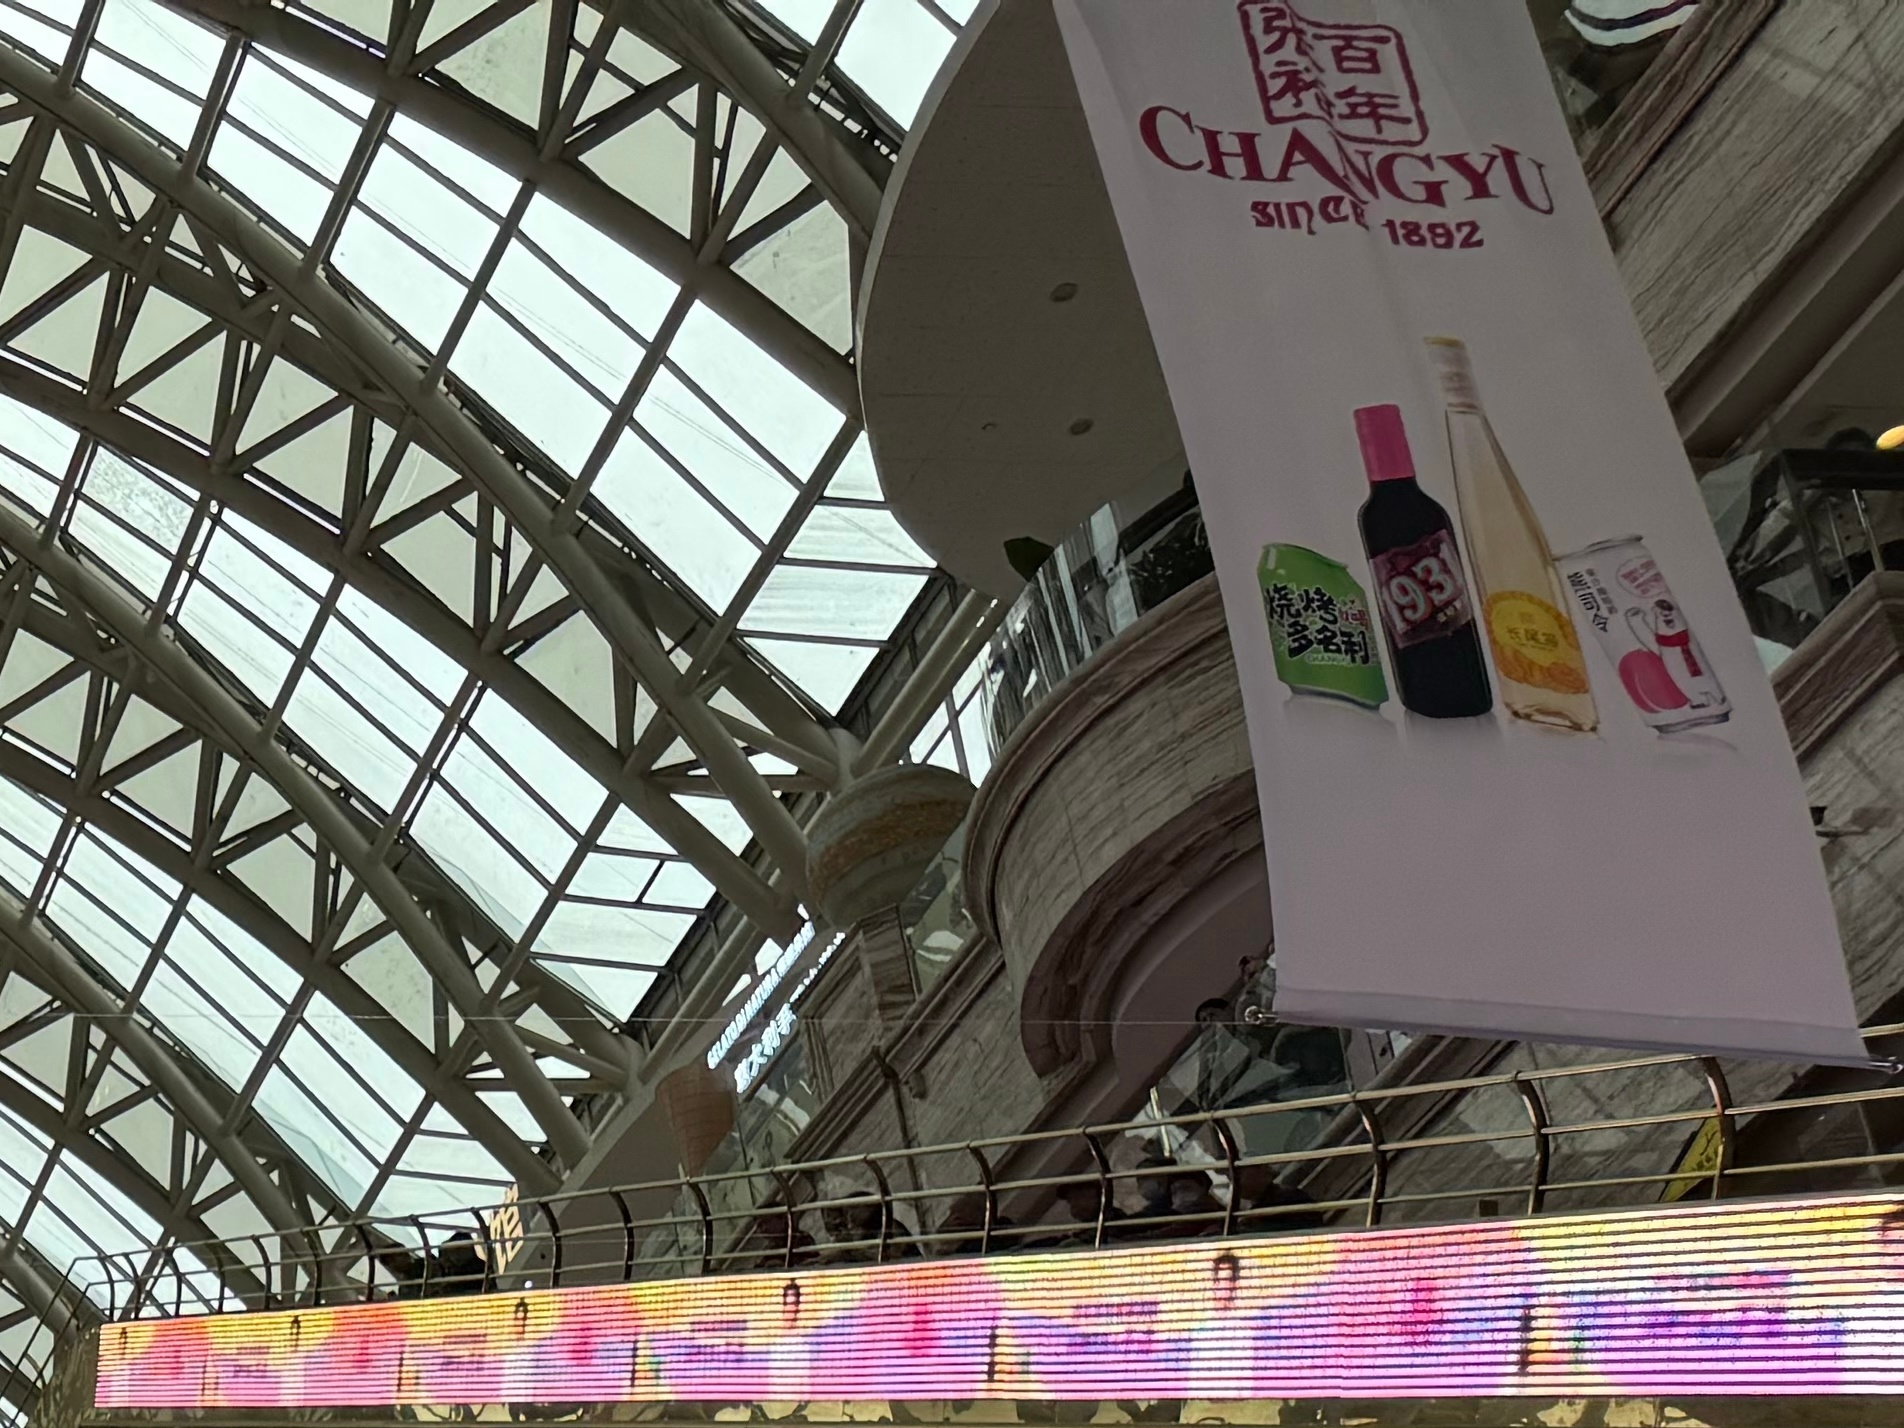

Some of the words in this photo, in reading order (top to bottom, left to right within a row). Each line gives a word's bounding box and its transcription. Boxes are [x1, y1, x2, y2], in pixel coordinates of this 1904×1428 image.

[1138, 105, 1555, 216] CHANGYU
[1381, 217, 1485, 250] 1892
[1287, 620, 1370, 666] 多名利
